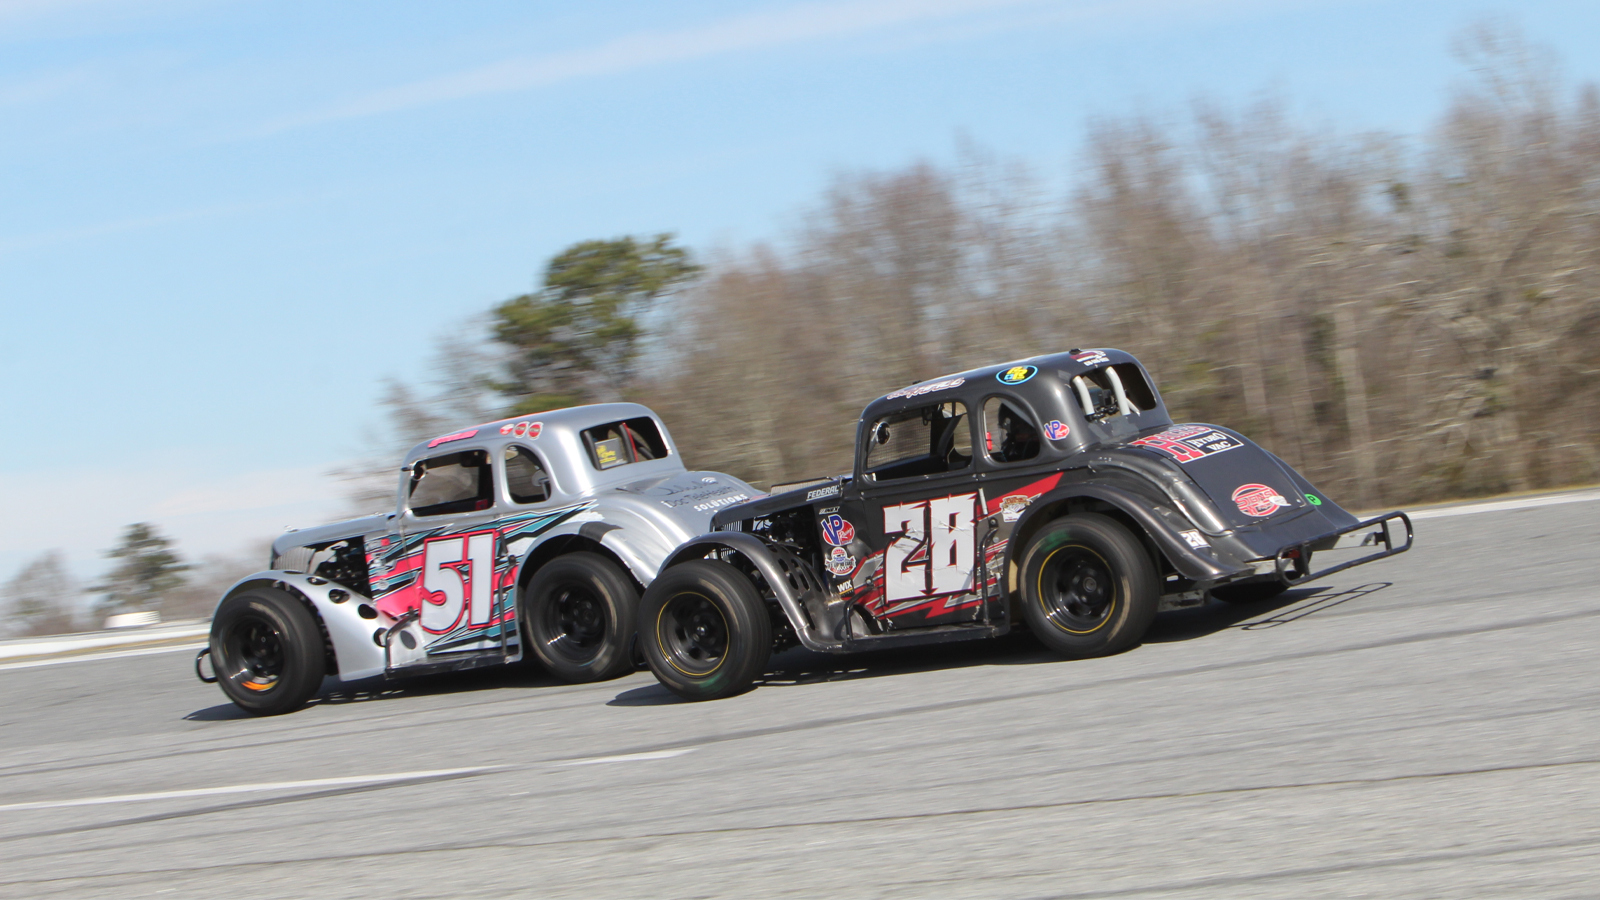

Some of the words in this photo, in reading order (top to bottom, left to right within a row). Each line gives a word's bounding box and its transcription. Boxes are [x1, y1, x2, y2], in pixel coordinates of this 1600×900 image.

[1044, 420, 1061, 440] VP
[1186, 432, 1227, 448] HYDRO
[1206, 441, 1231, 451] VAC
[807, 485, 839, 499] FEDERAL
[694, 494, 748, 512] SOLUTIONS
[821, 514, 844, 545] VP
[1180, 530, 1209, 547] 28
[882, 492, 978, 605] 28
[418, 529, 496, 635] 51
[837, 580, 852, 592] WIX
